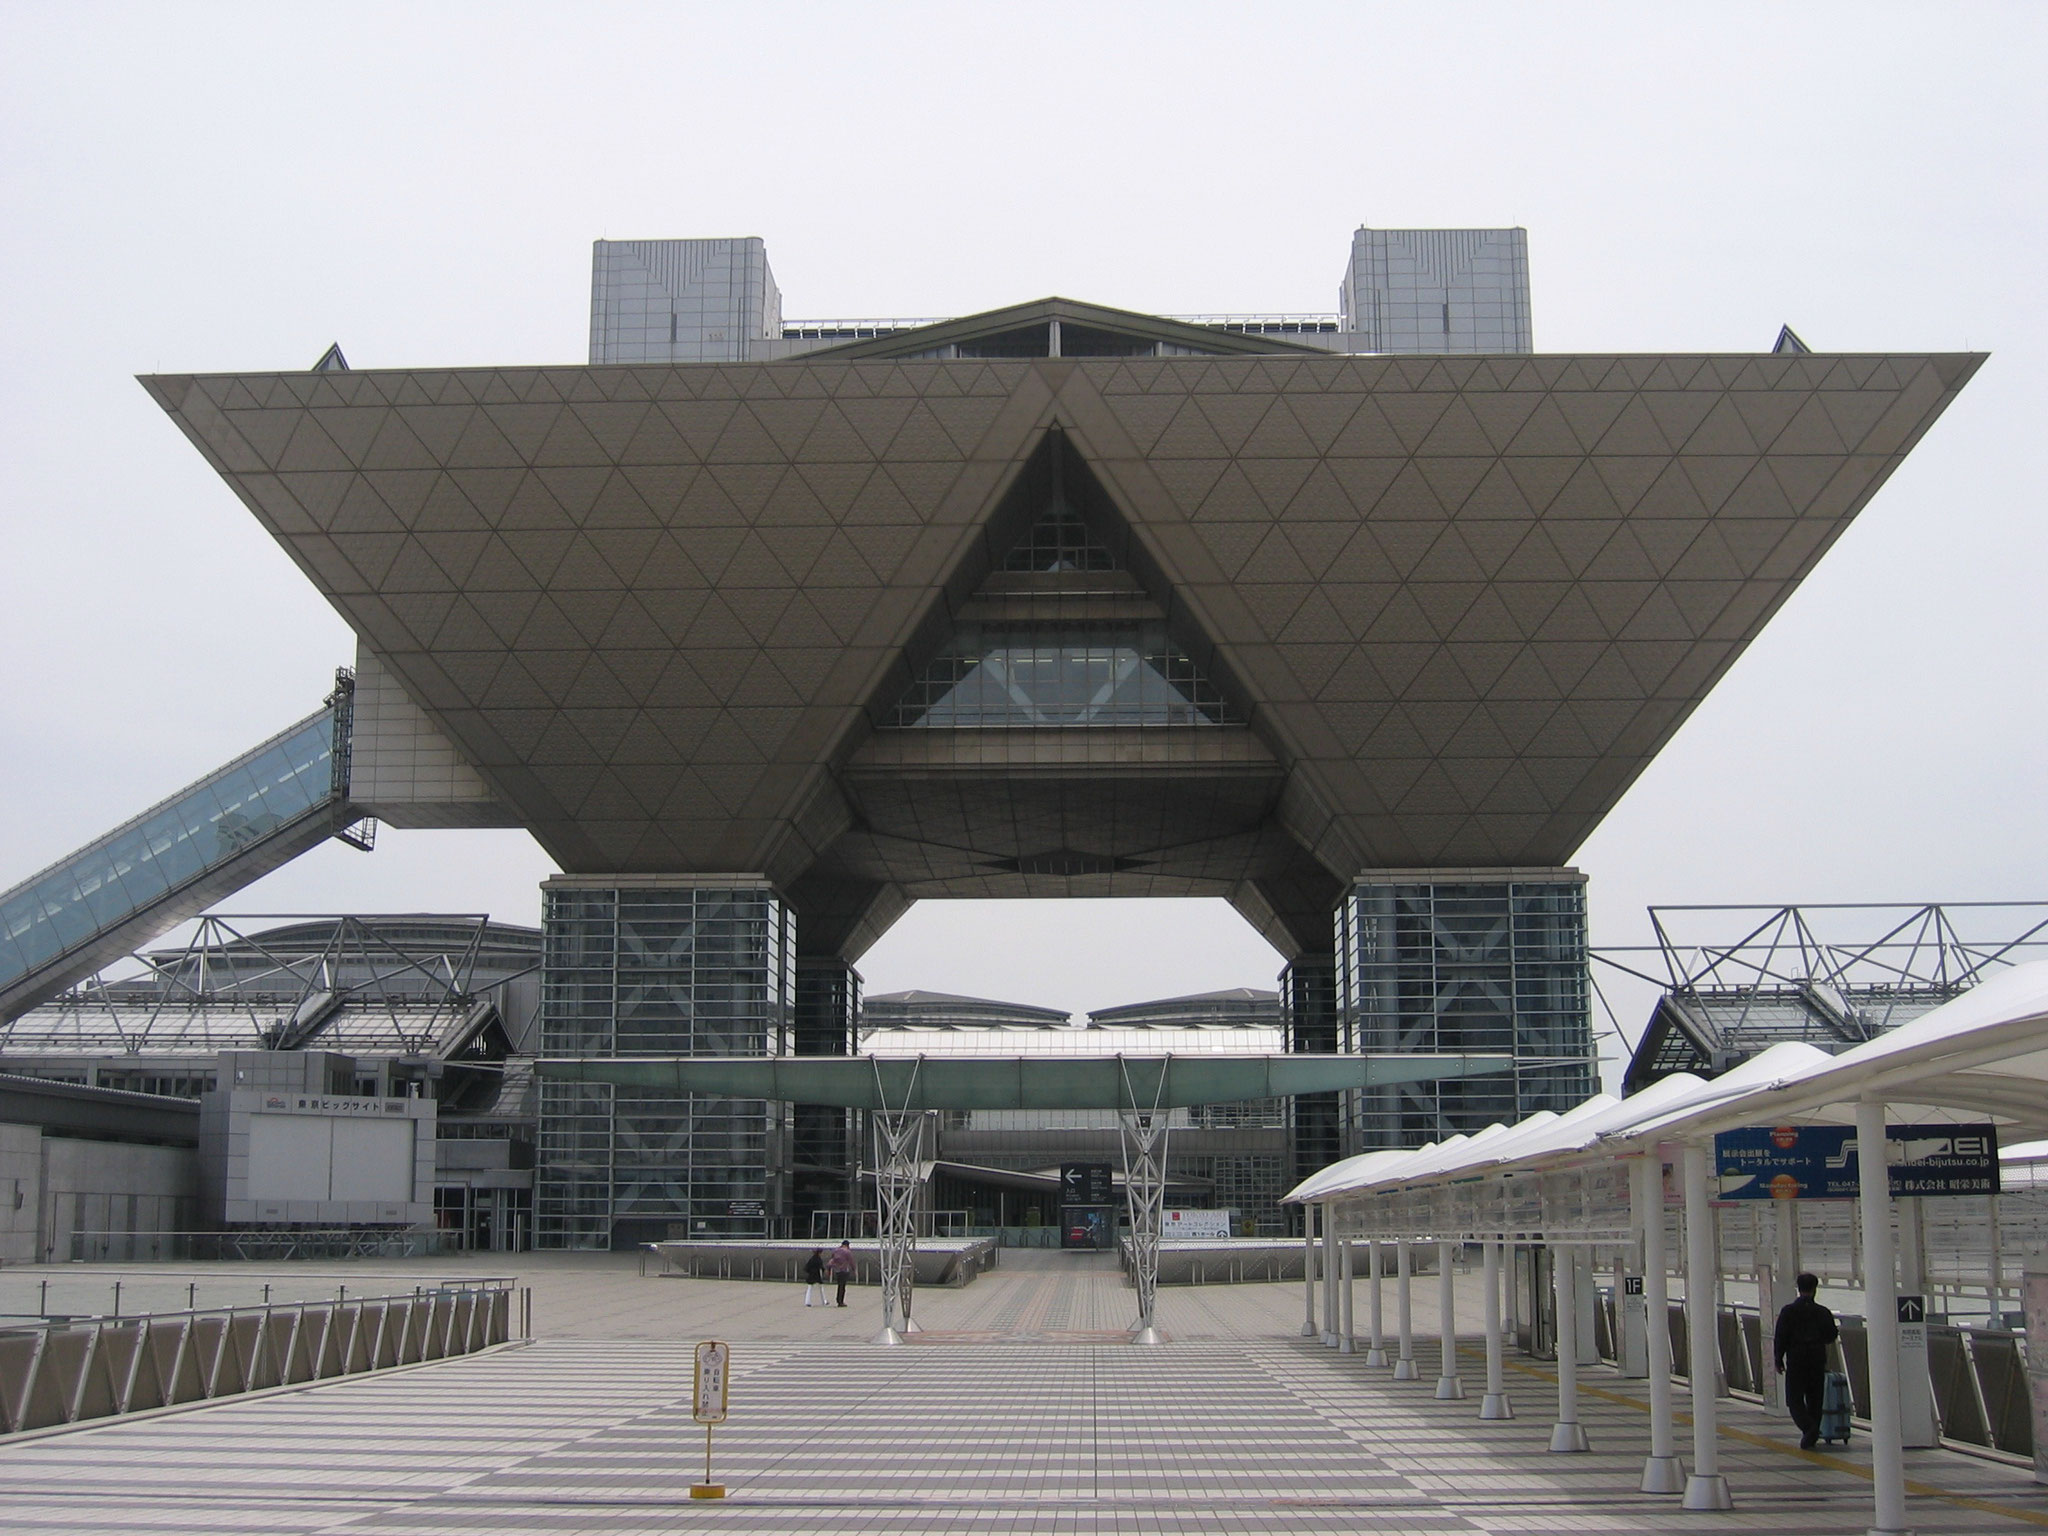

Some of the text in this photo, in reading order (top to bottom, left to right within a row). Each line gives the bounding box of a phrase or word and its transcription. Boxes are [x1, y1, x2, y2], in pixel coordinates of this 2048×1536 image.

[298, 1099, 380, 1111] 東京ビッグサイト
[1740, 1157, 1812, 1167] トータルでサポート
[1904, 1179, 1946, 1190] 株式会社
[1626, 1279, 1641, 1293] 1F
